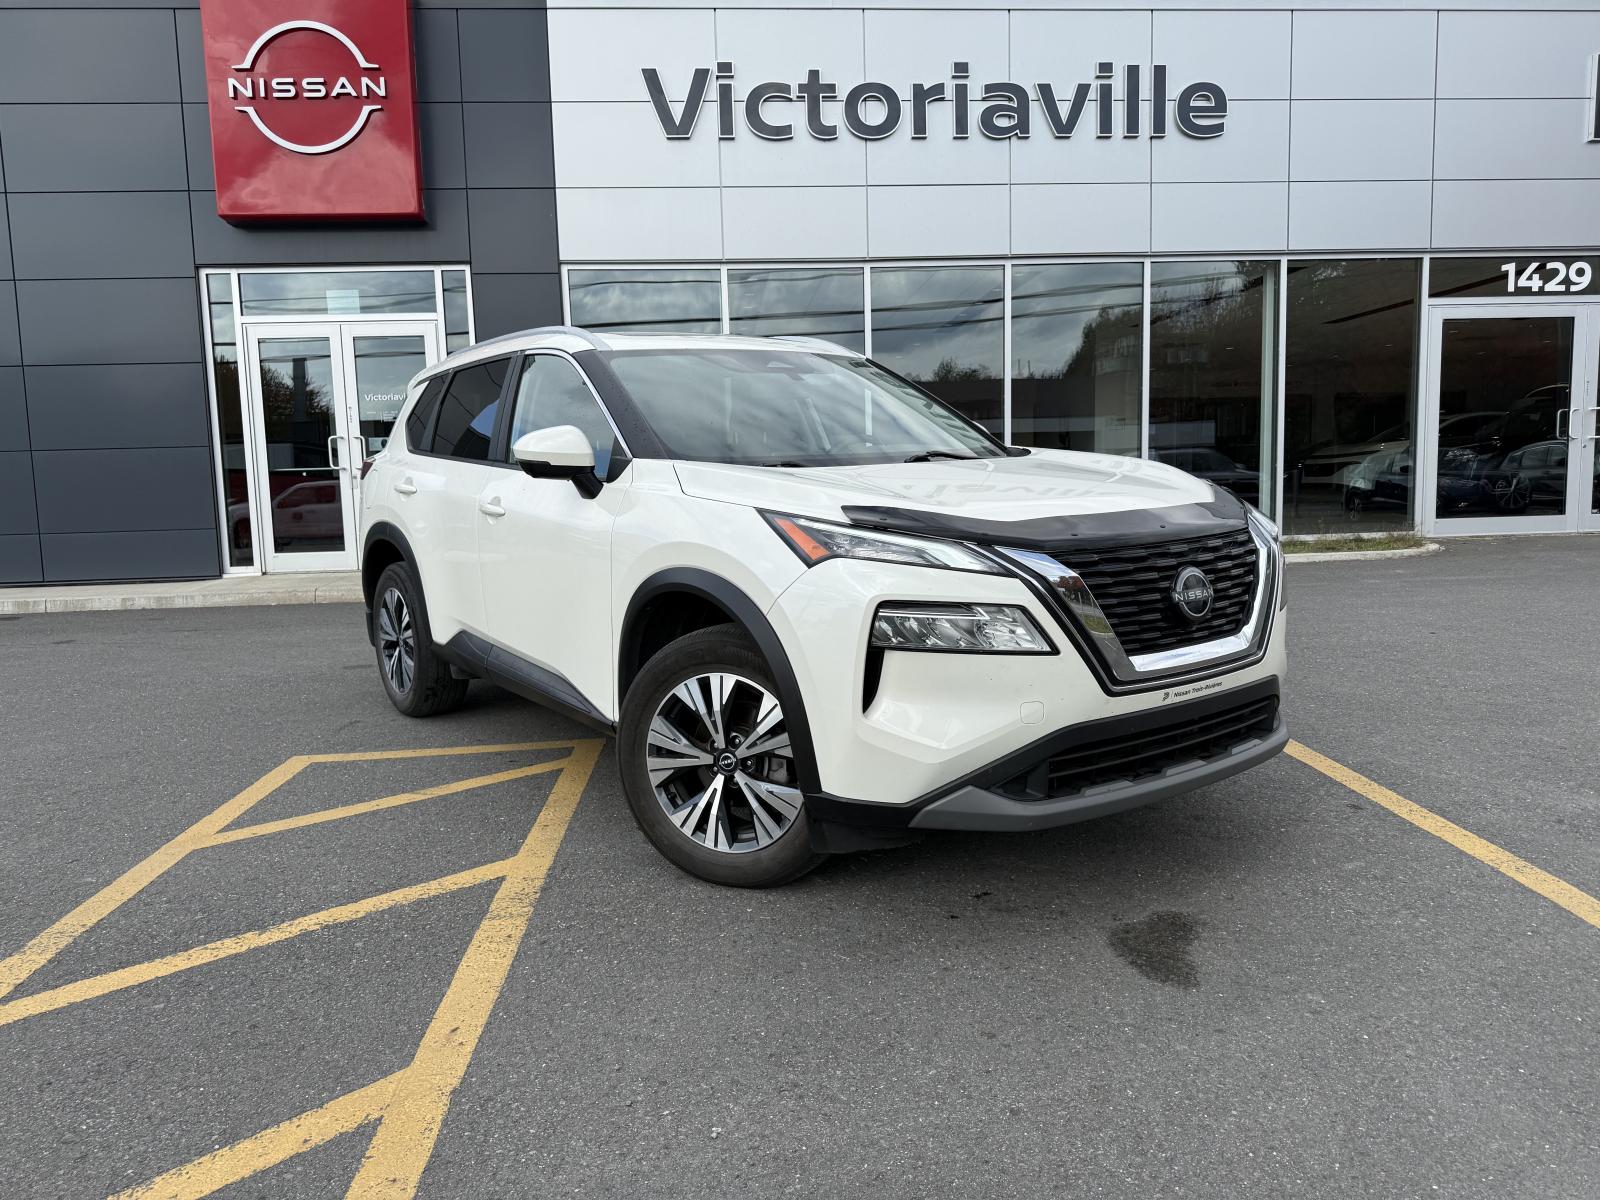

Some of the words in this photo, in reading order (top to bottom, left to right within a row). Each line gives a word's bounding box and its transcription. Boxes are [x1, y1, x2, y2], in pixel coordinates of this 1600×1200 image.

[227, 76, 387, 99] NISSAN
[640, 61, 1230, 141] Victoriaville
[1500, 261, 1593, 293] 1429
[1175, 588, 1214, 602] NISSAN
